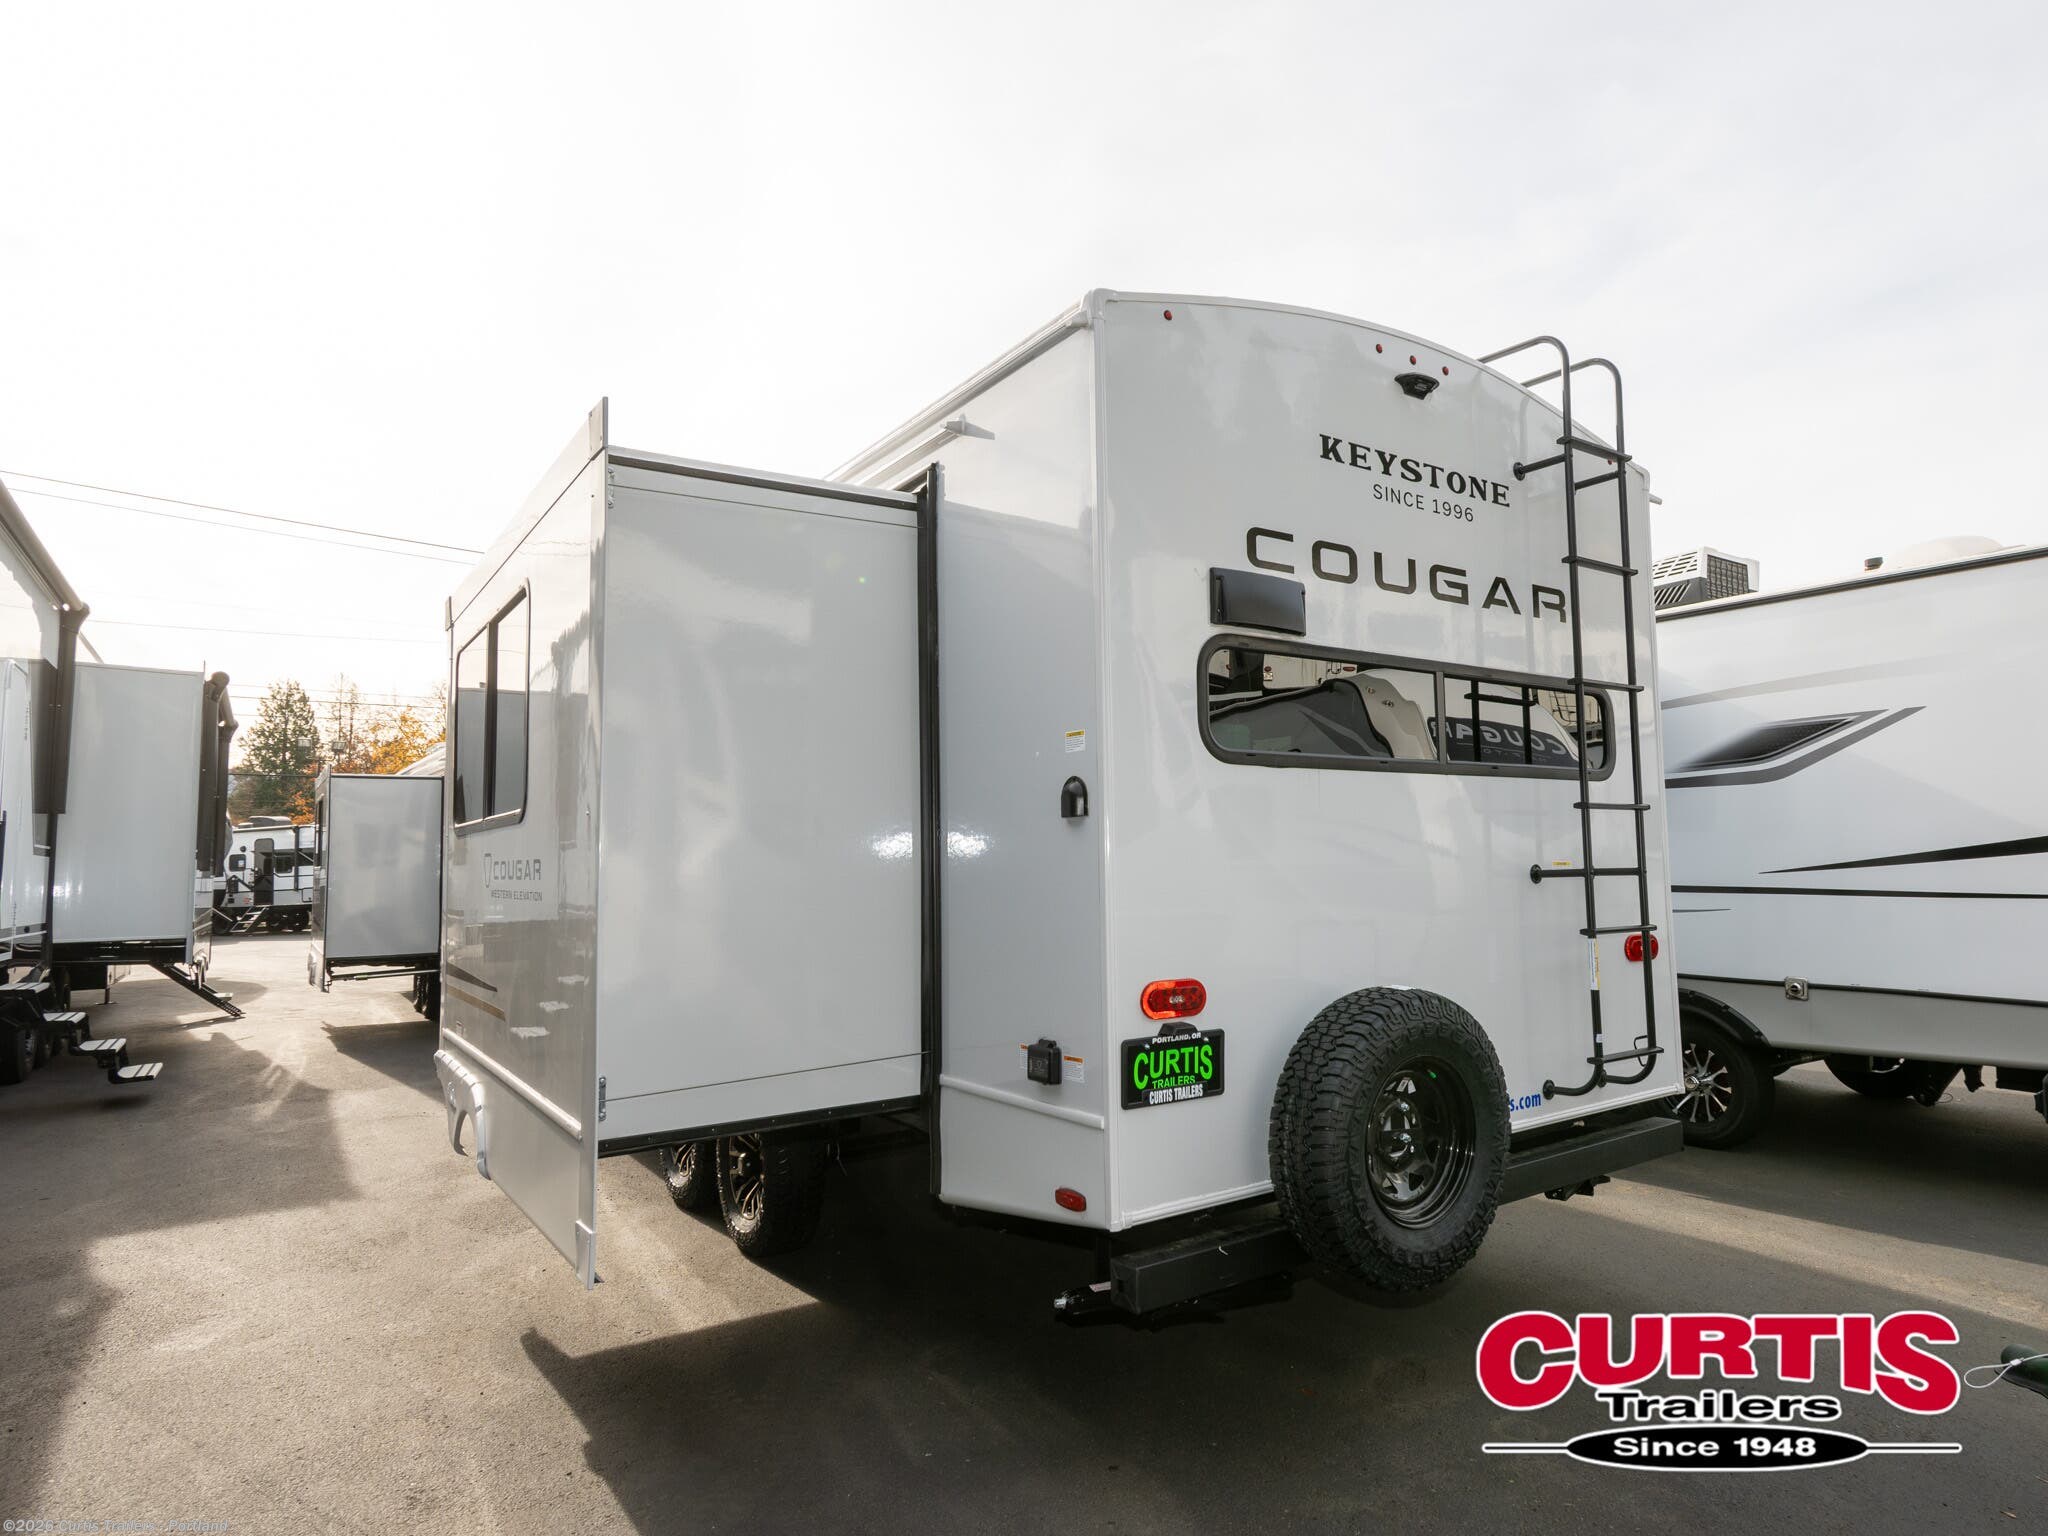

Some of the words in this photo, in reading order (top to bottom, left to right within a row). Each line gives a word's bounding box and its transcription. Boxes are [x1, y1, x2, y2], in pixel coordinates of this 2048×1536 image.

[1319, 433, 1511, 508] KEYSTONE
[1373, 484, 1425, 511] SINCE
[1432, 499, 1475, 523] 1996
[1246, 526, 1568, 624] COUGAR
[493, 859, 542, 881] COUGAR
[513, 890, 543, 902] ELEVATION
[1191, 1031, 1202, 1040] OR
[1133, 1044, 1214, 1090] CURTIS
[1151, 1075, 1196, 1090] TRAILERS
[1149, 1087, 1174, 1105] CURTIS
[1173, 1083, 1204, 1101] TRAILERS
[1509, 1093, 1542, 1112] s.com
